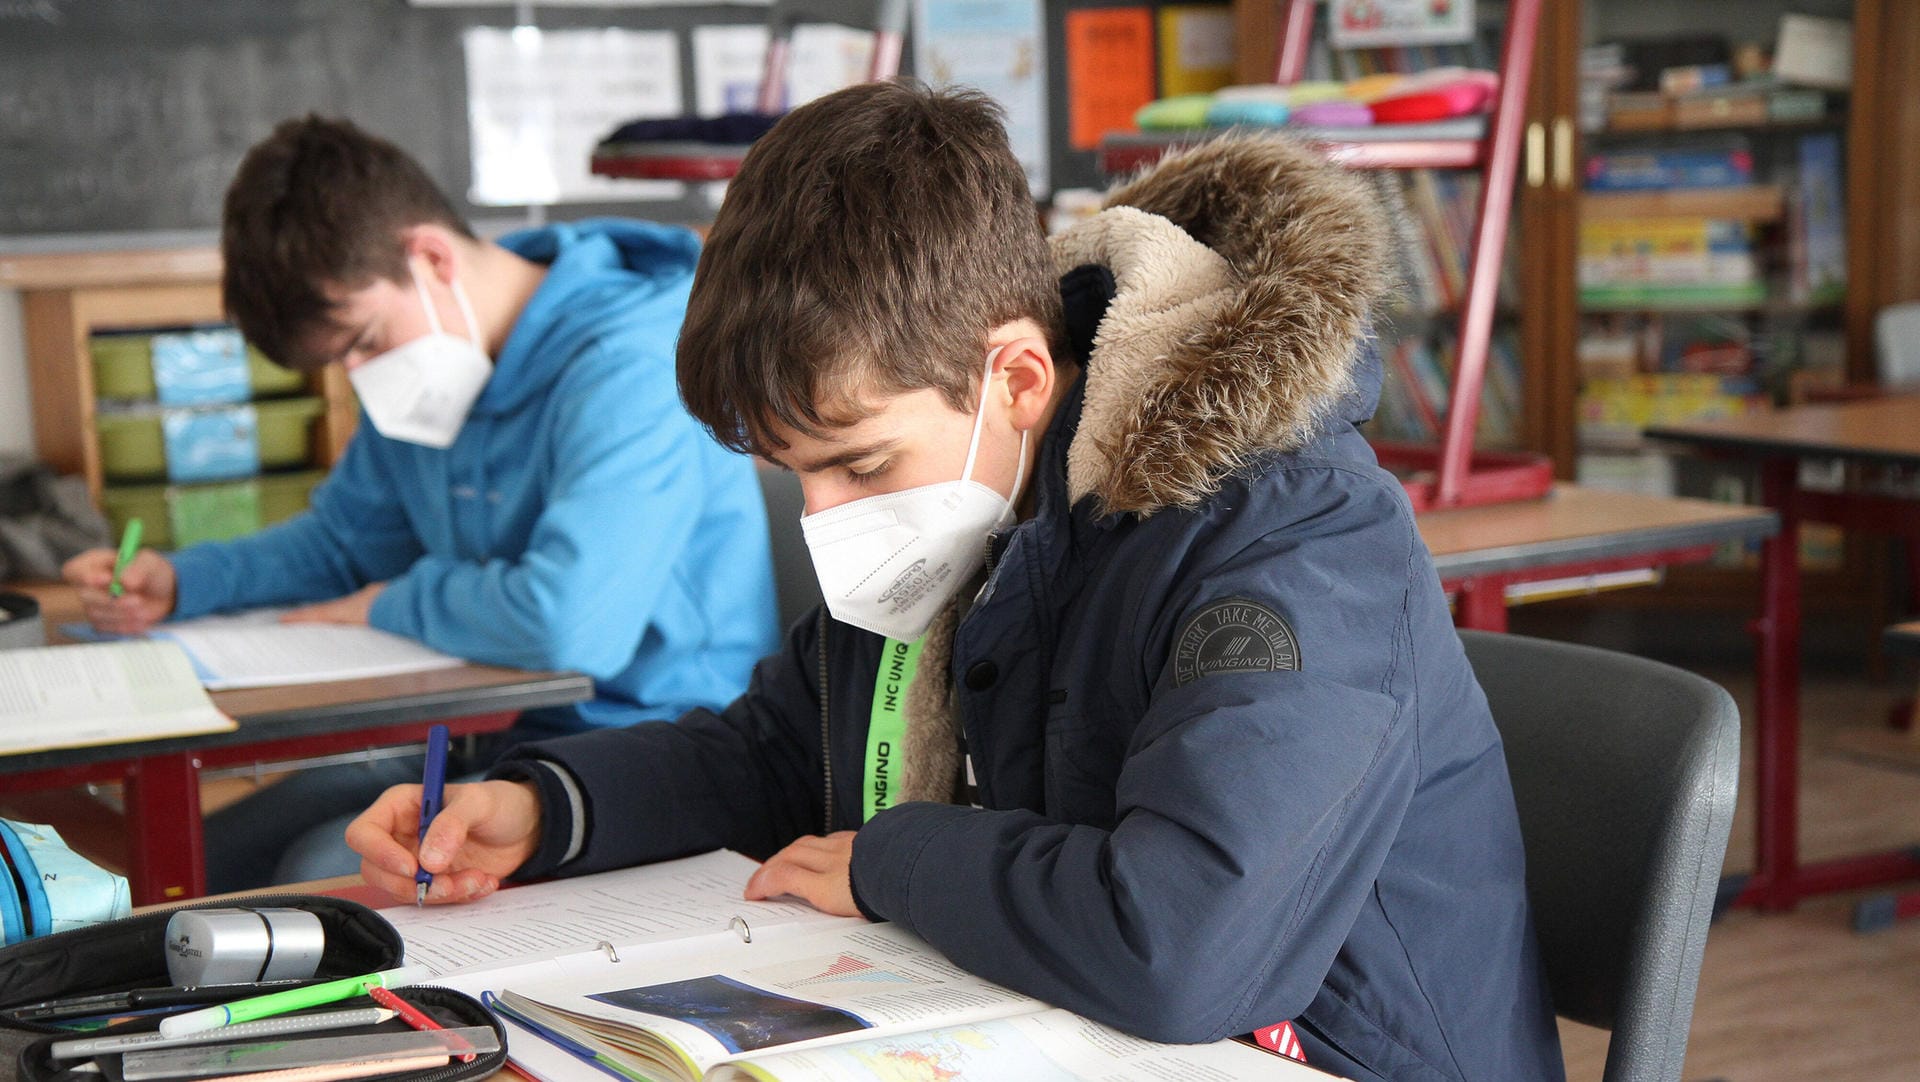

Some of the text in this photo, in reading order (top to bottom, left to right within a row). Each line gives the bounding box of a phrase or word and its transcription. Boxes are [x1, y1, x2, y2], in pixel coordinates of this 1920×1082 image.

[1180, 623, 1208, 660] MARK
[1212, 607, 1252, 625] TAKE
[1252, 613, 1275, 634] ME
[1268, 631, 1289, 650] ON
[889, 643, 909, 681] UNIQ
[1200, 657, 1271, 670] VINGINO
[884, 684, 899, 712] INC
